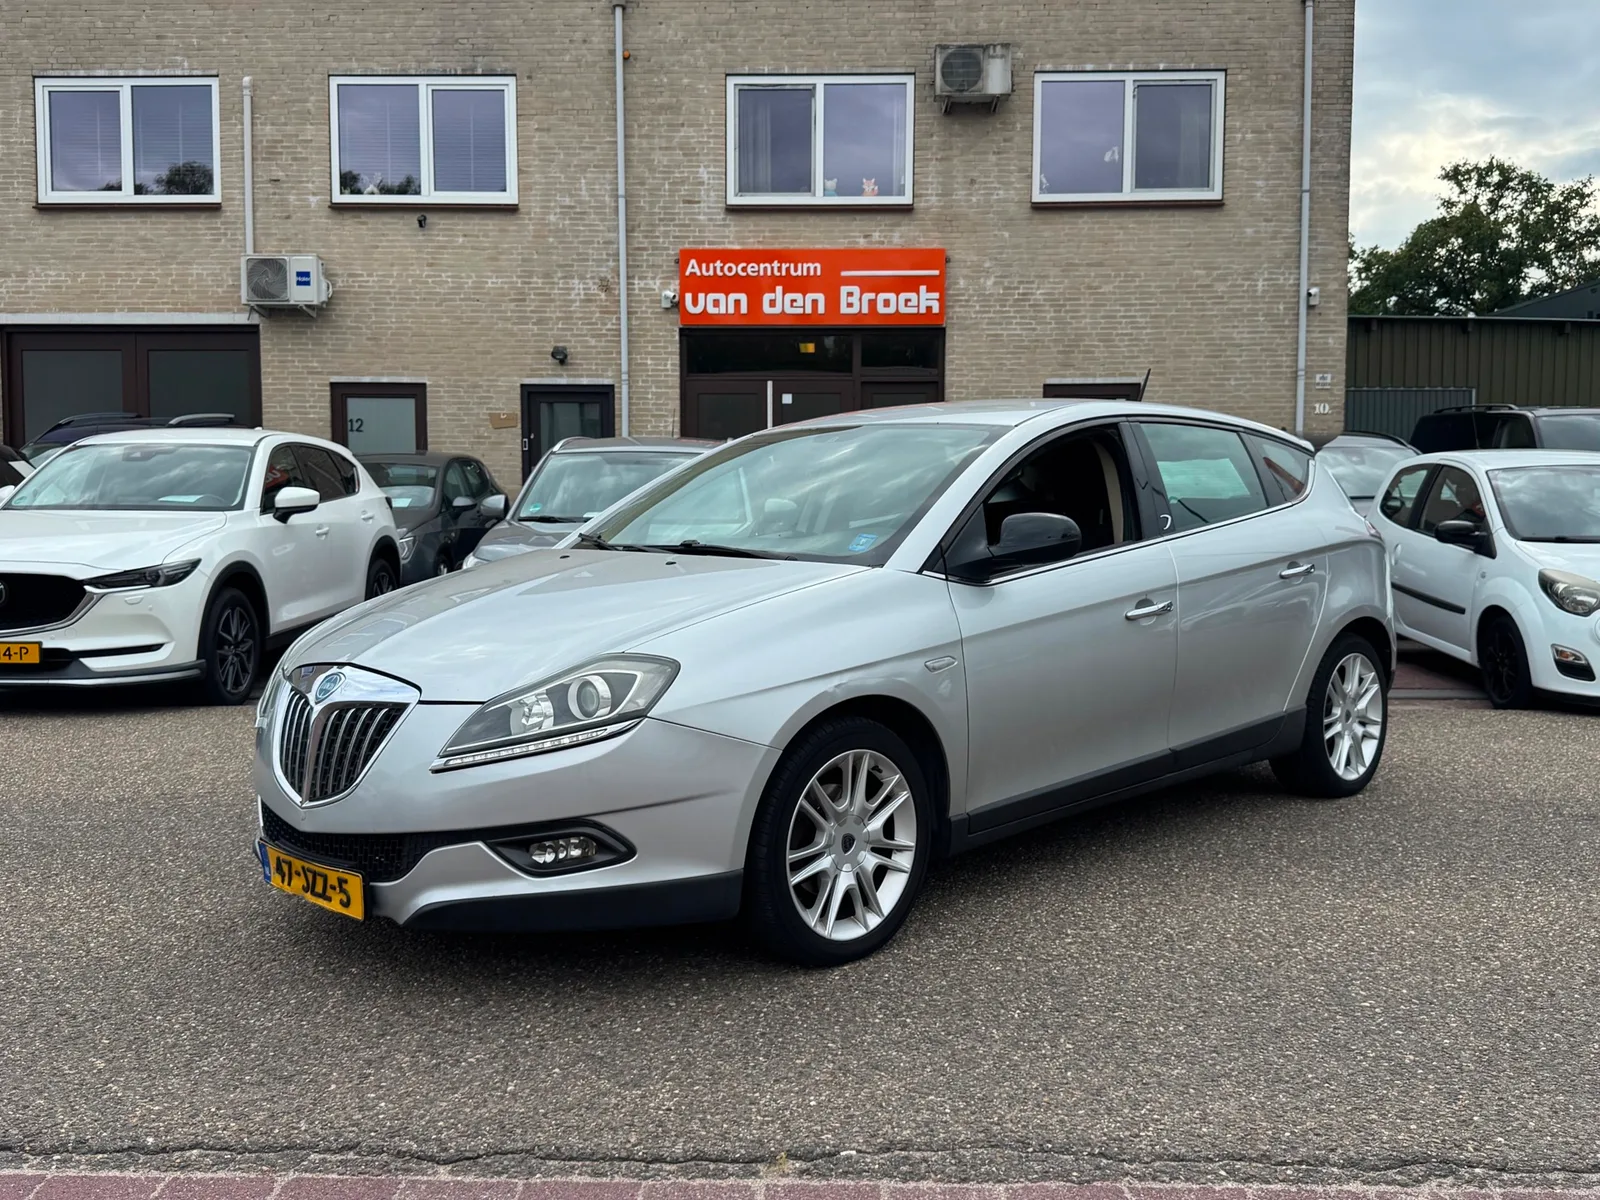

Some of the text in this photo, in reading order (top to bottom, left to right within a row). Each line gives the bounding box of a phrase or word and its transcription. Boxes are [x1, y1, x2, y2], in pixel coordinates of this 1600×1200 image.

[685, 258, 822, 277] Autocentrum
[685, 285, 940, 315] van den Broek
[348, 417, 364, 433] 12
[0, 646, 29, 661] 4-P
